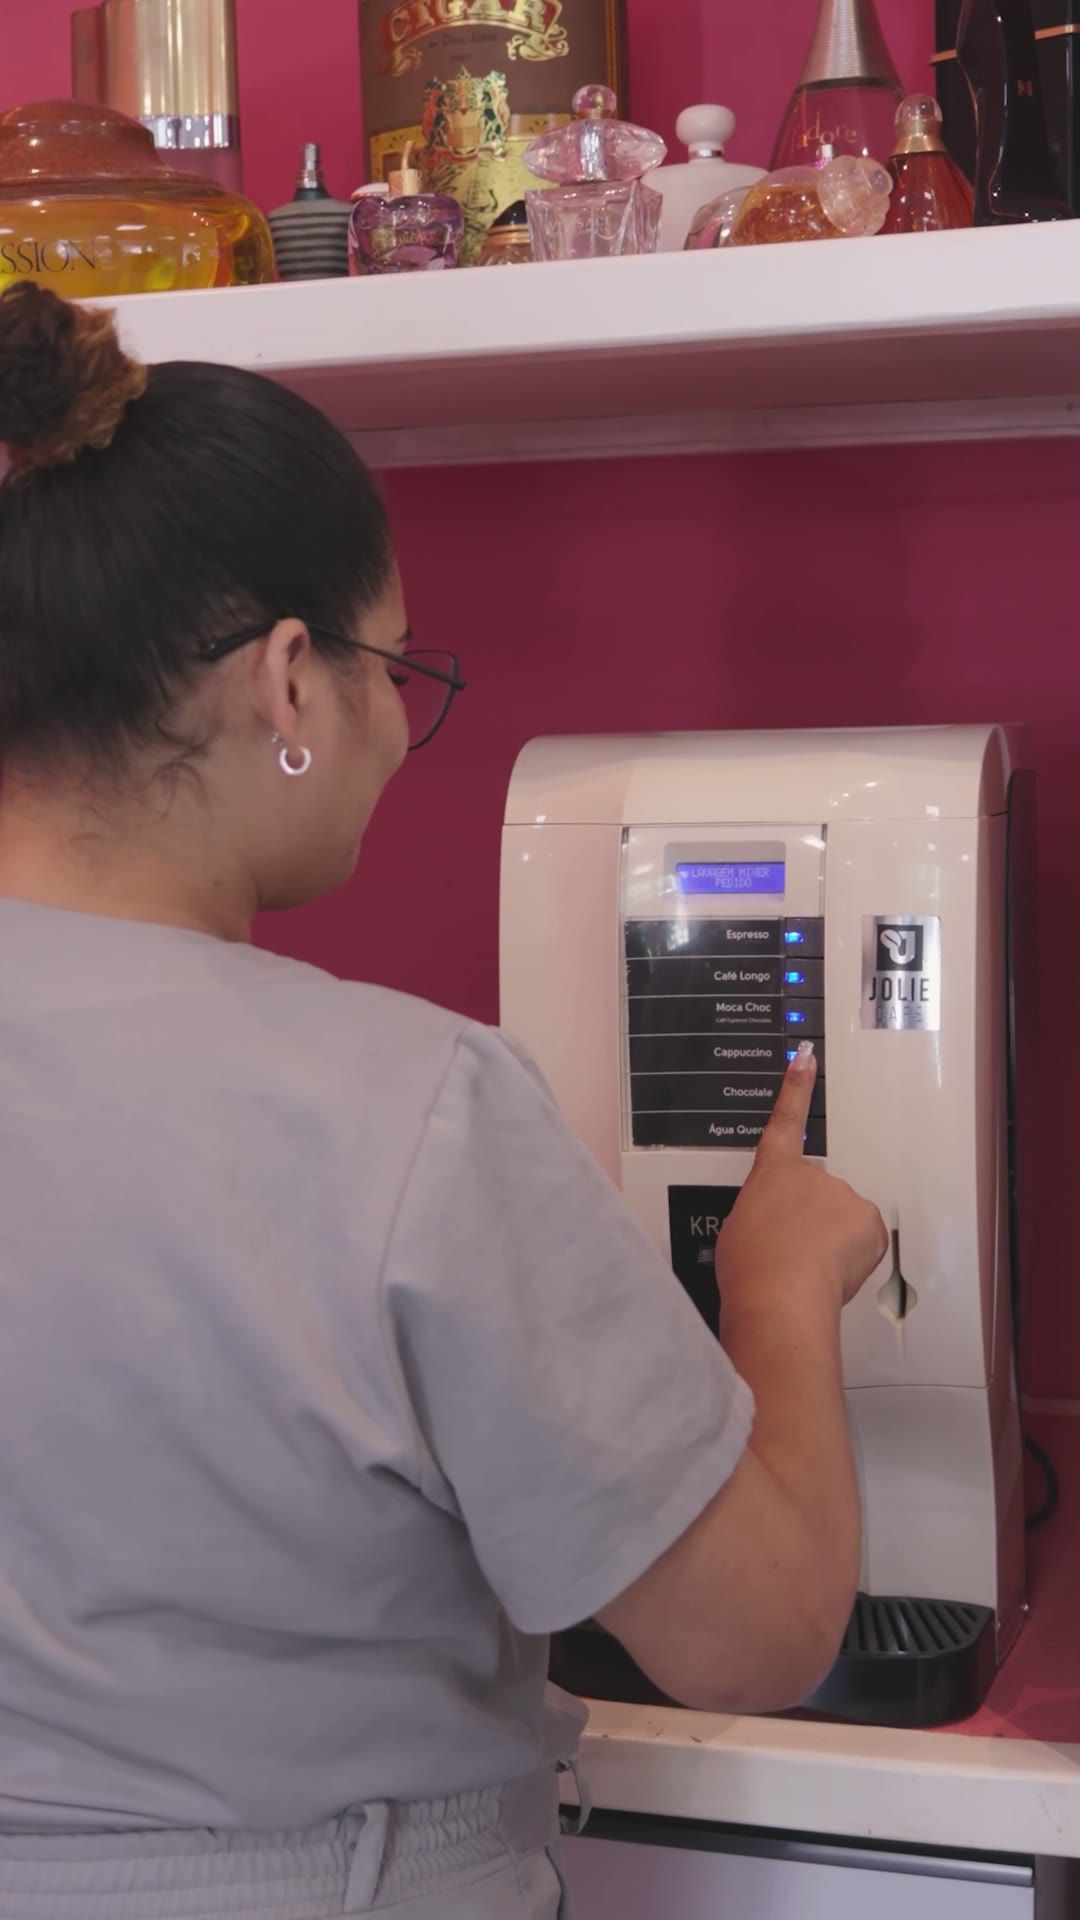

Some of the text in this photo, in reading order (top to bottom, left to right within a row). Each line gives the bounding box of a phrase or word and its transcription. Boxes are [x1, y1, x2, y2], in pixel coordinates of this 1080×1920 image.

[0, 240, 96, 275] SSION
[715, 879, 752, 888] PEDIDO
[726, 929, 770, 941] Espresso
[714, 970, 770, 983] Café Longo
[869, 976, 930, 1002] JOLIE
[716, 1002, 771, 1012] Moca Choc
[713, 1047, 773, 1059] Cappuccino
[723, 1087, 773, 1097] Chocolate
[709, 1123, 765, 1136] Água Quen
[690, 1216, 720, 1237] KR
